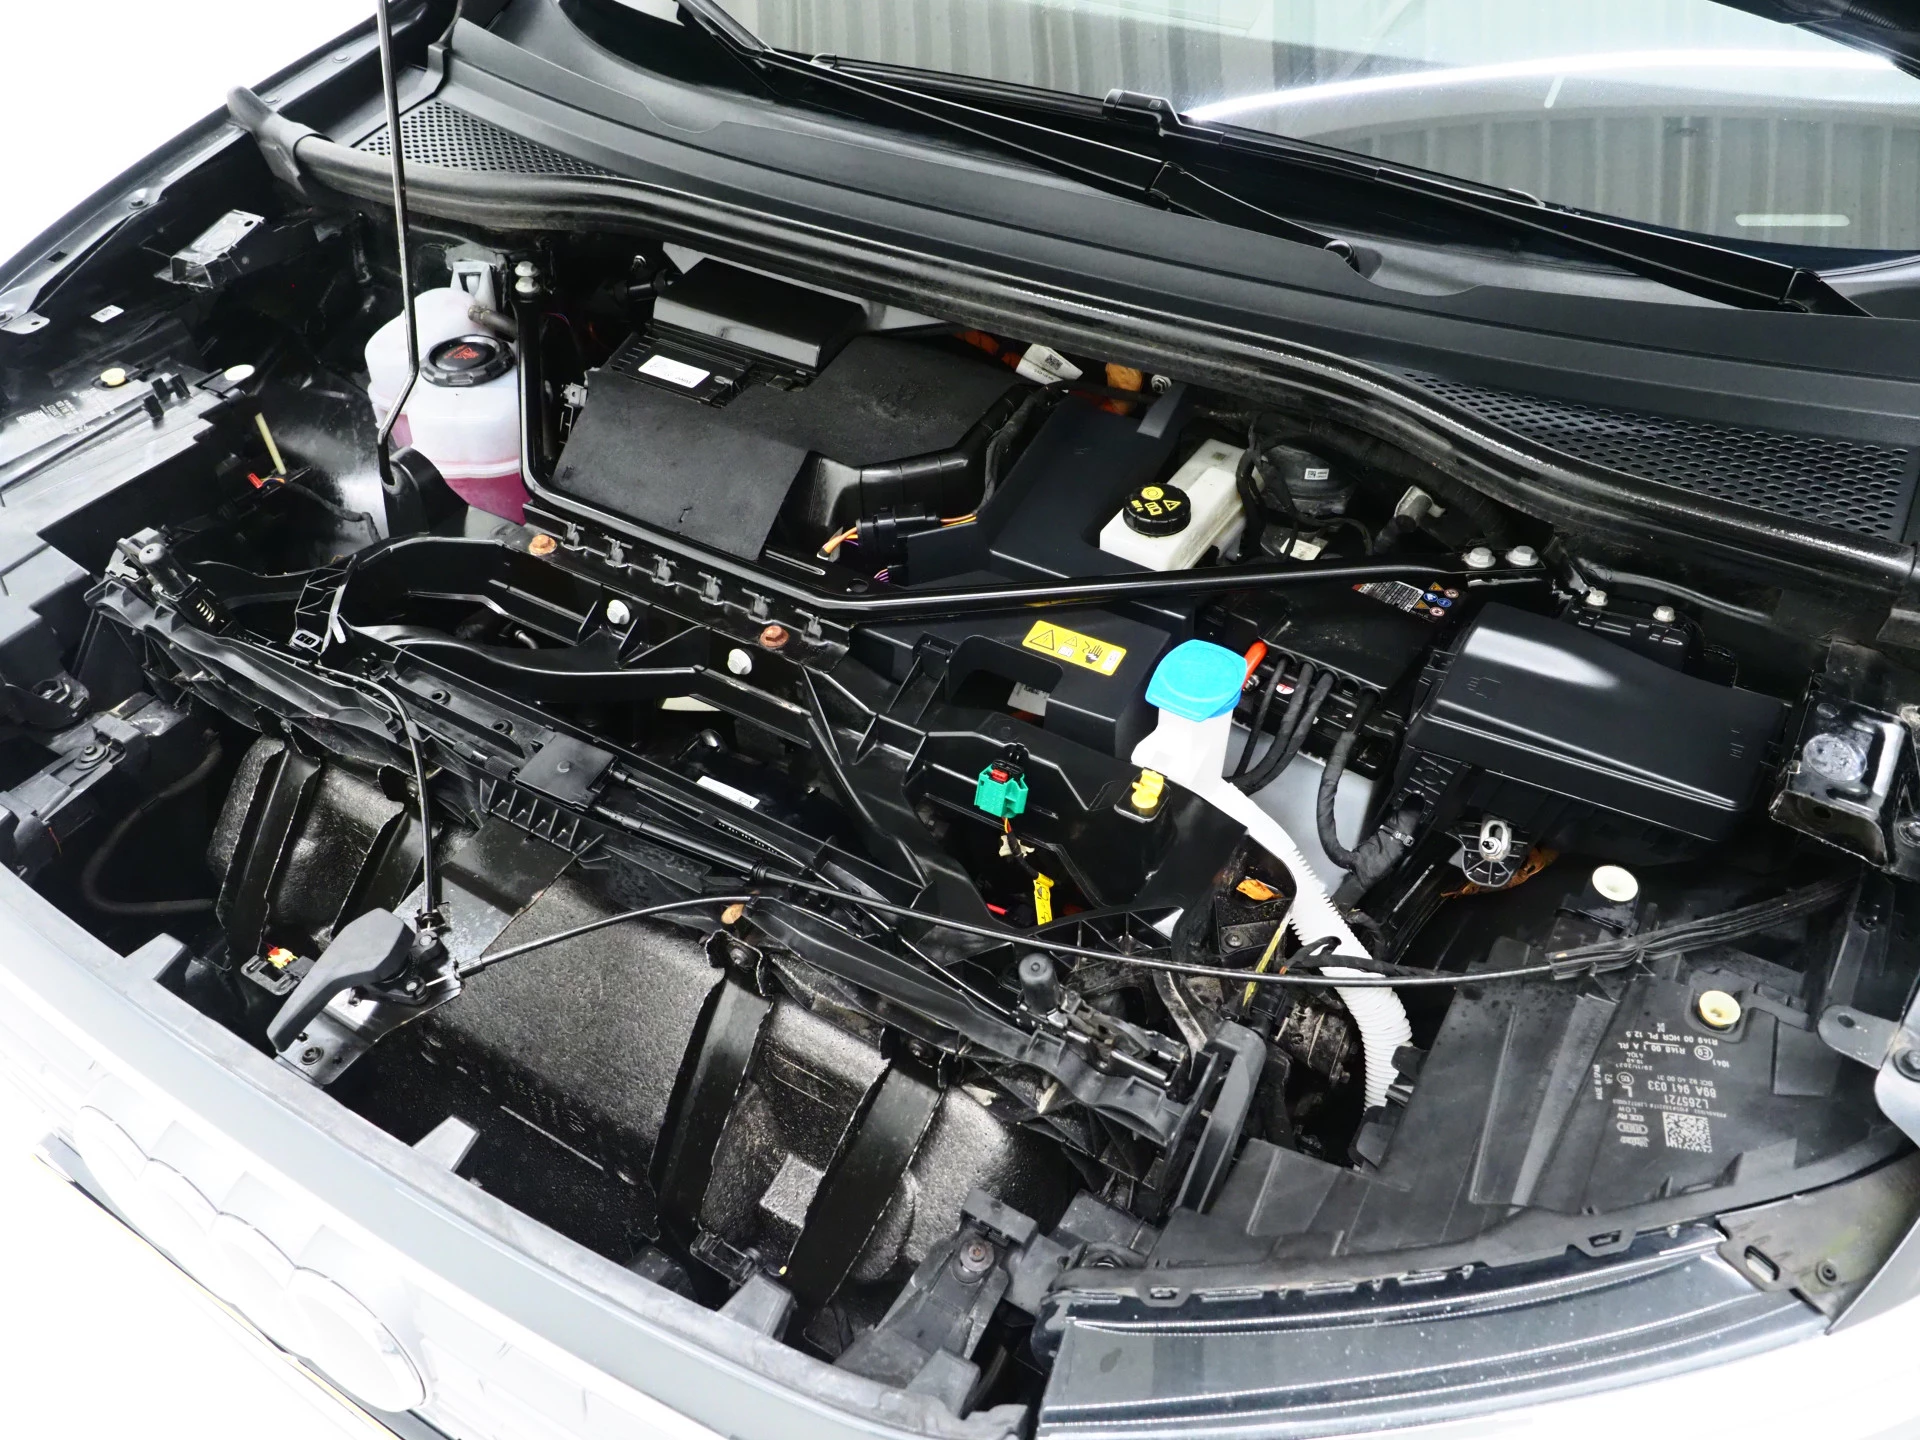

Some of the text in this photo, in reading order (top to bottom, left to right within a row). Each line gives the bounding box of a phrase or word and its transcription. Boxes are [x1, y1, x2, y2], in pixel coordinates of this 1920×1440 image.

[1647, 1031, 1659, 1040] PL
[1683, 1035, 1694, 1043] 00
[1617, 1042, 1630, 1050] RL
[1632, 1042, 1639, 1050] A
[1651, 1045, 1662, 1053] 00
[1696, 1047, 1711, 1059] E9
[1712, 1059, 1730, 1068] 1041
[1621, 1085, 1633, 1098] L
[1647, 1079, 1717, 1098] 89A 941 033
[1664, 1094, 1709, 1109] L265721
[1618, 1105, 1637, 1114] LOW
